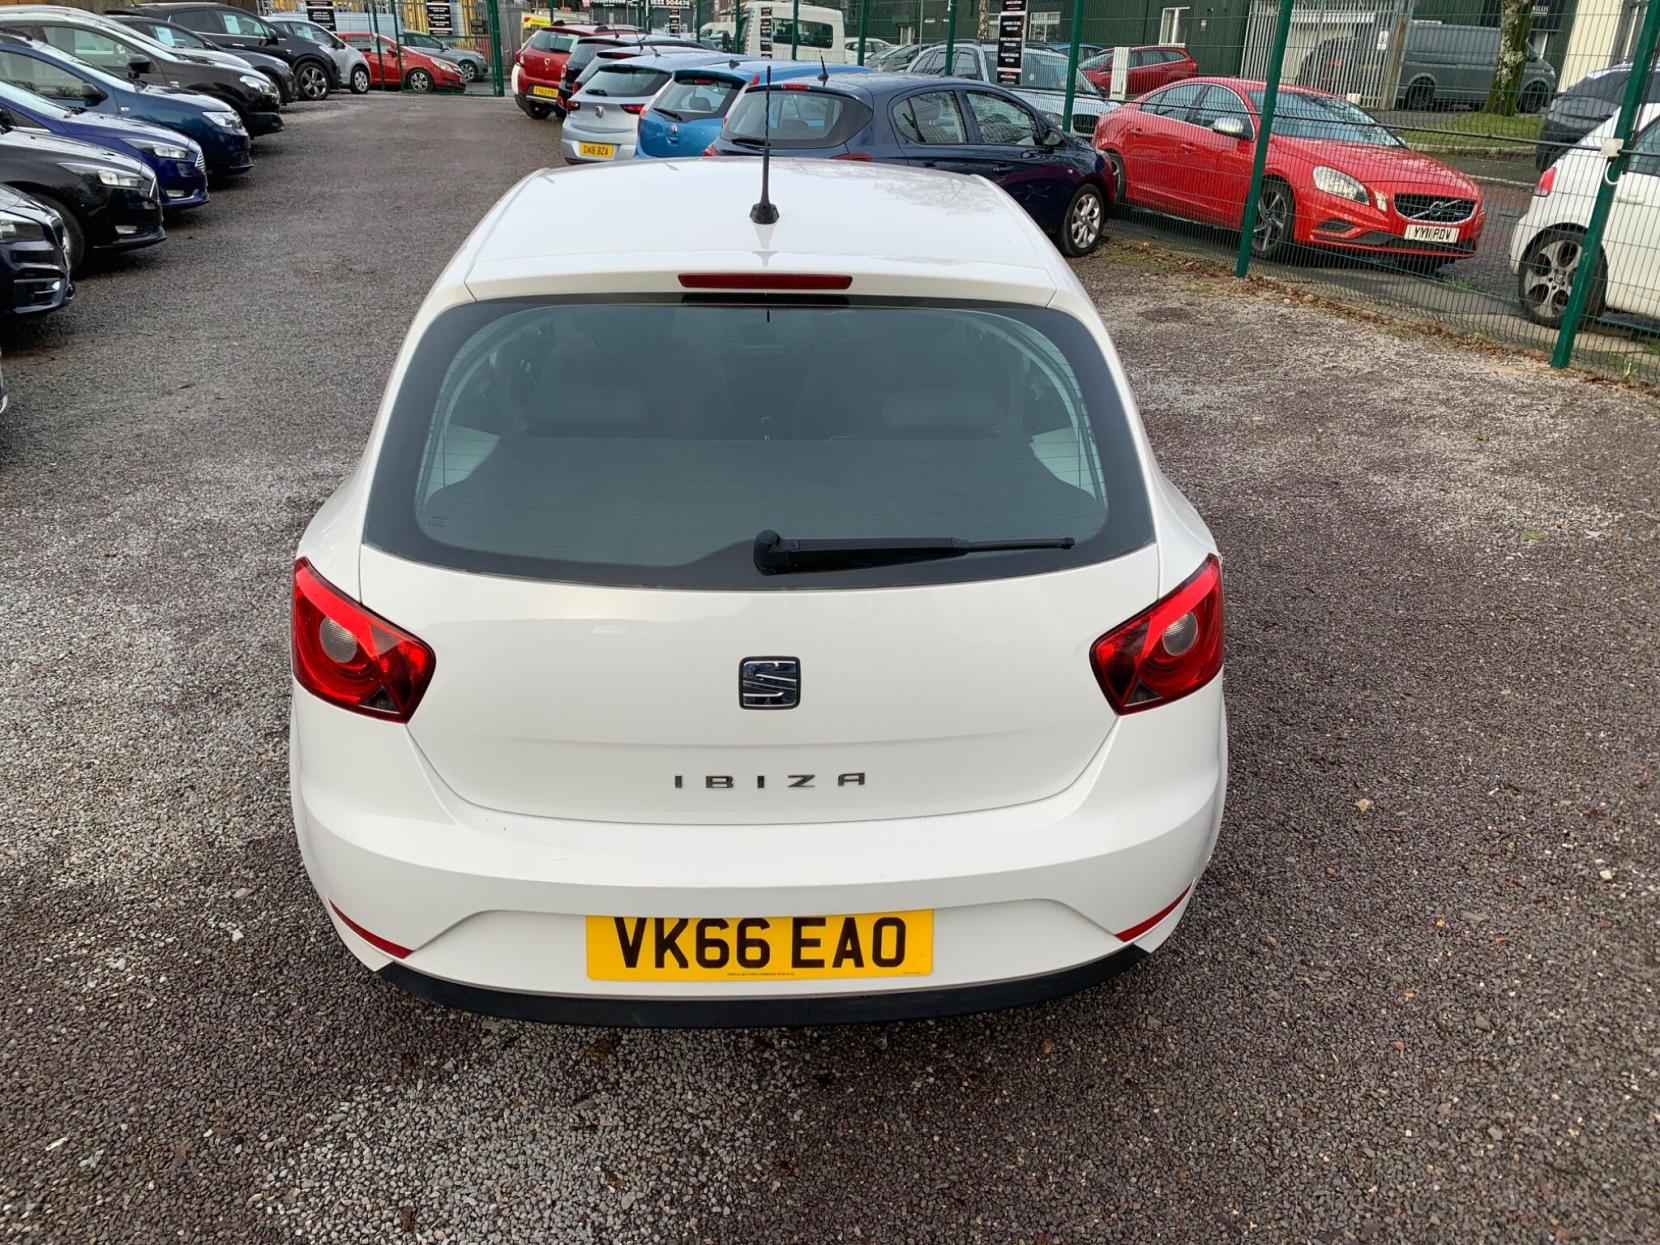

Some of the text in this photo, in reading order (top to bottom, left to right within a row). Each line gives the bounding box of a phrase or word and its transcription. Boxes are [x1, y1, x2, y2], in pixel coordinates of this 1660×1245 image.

[674, 772, 866, 789] IBIZA
[613, 916, 907, 969] VK66 EAO
